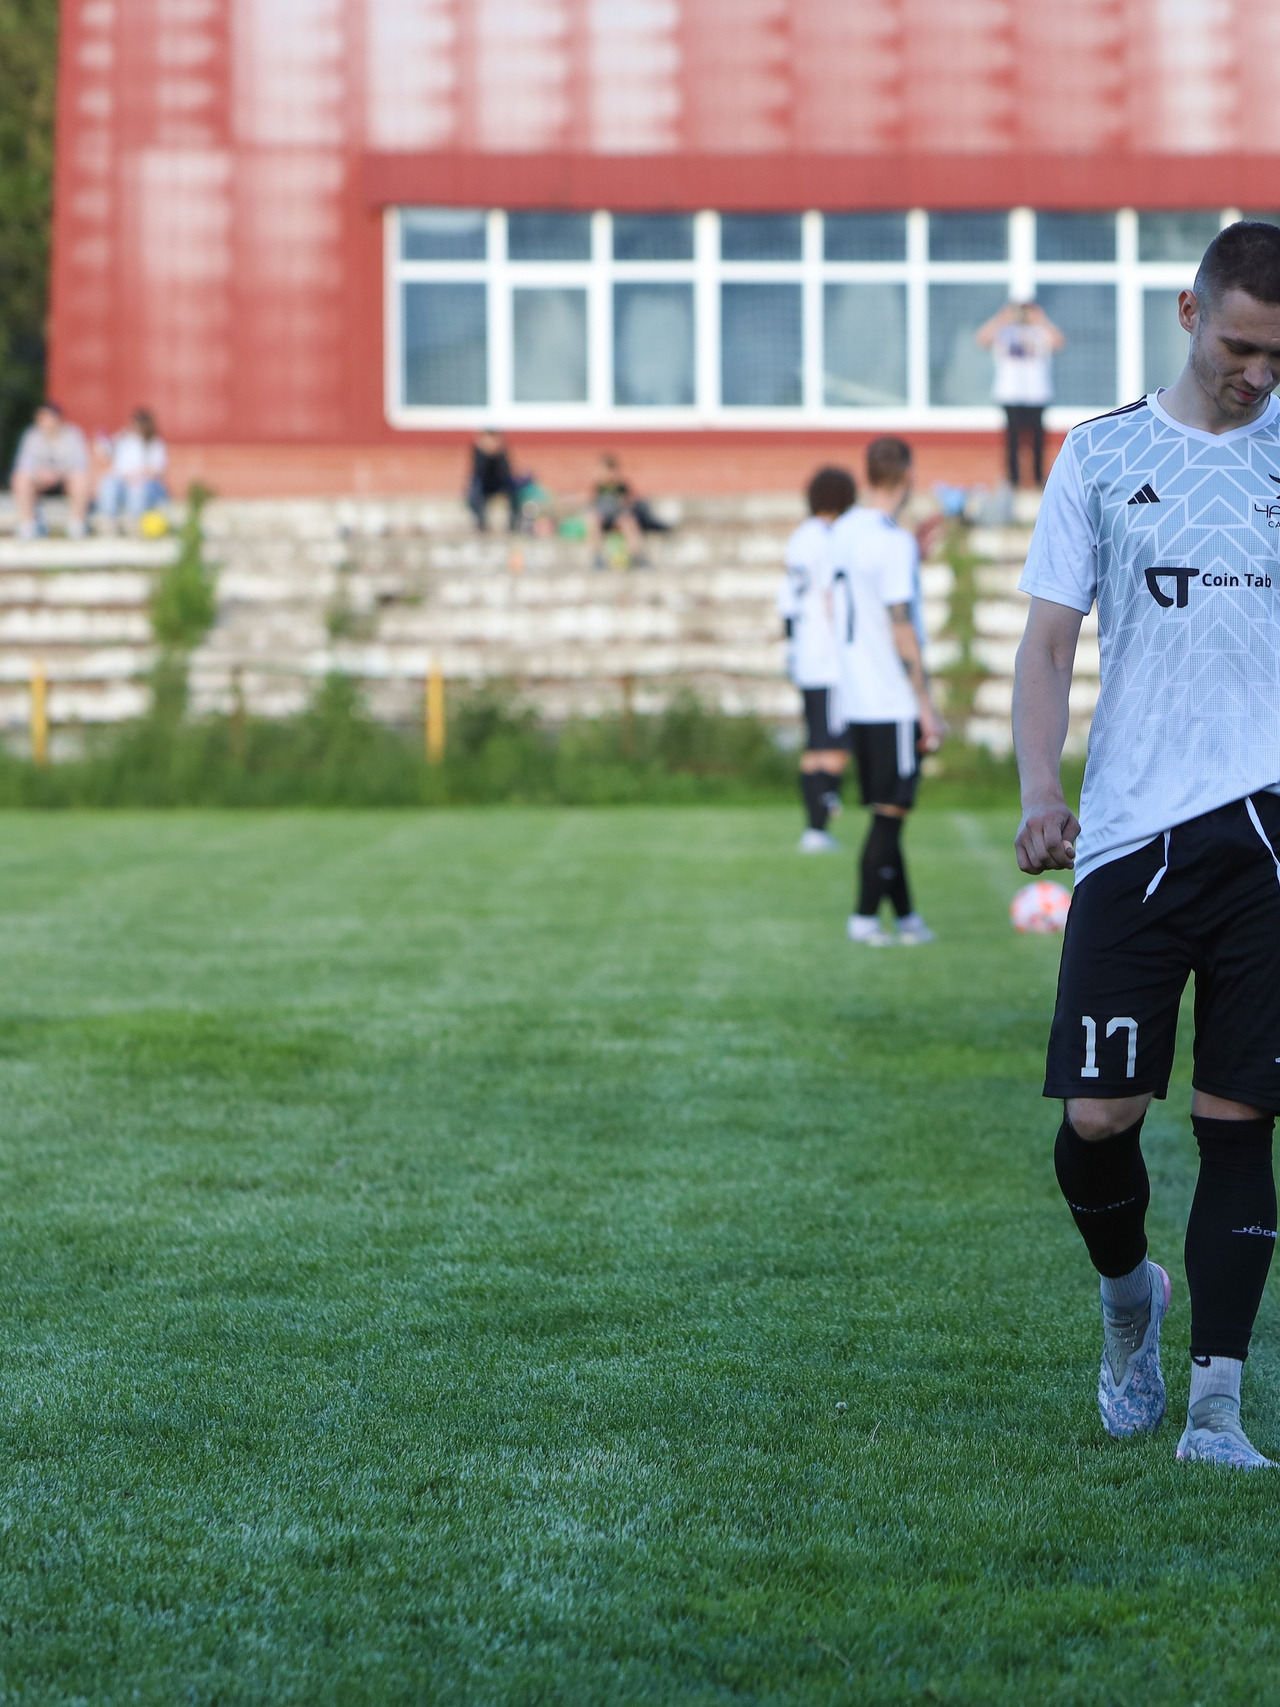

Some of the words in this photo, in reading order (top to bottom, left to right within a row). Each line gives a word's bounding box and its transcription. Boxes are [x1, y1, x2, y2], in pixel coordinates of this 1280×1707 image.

[1202, 573, 1239, 587] Coin
[1244, 573, 1272, 588] Tab
[1081, 1015, 1139, 1078] 17
